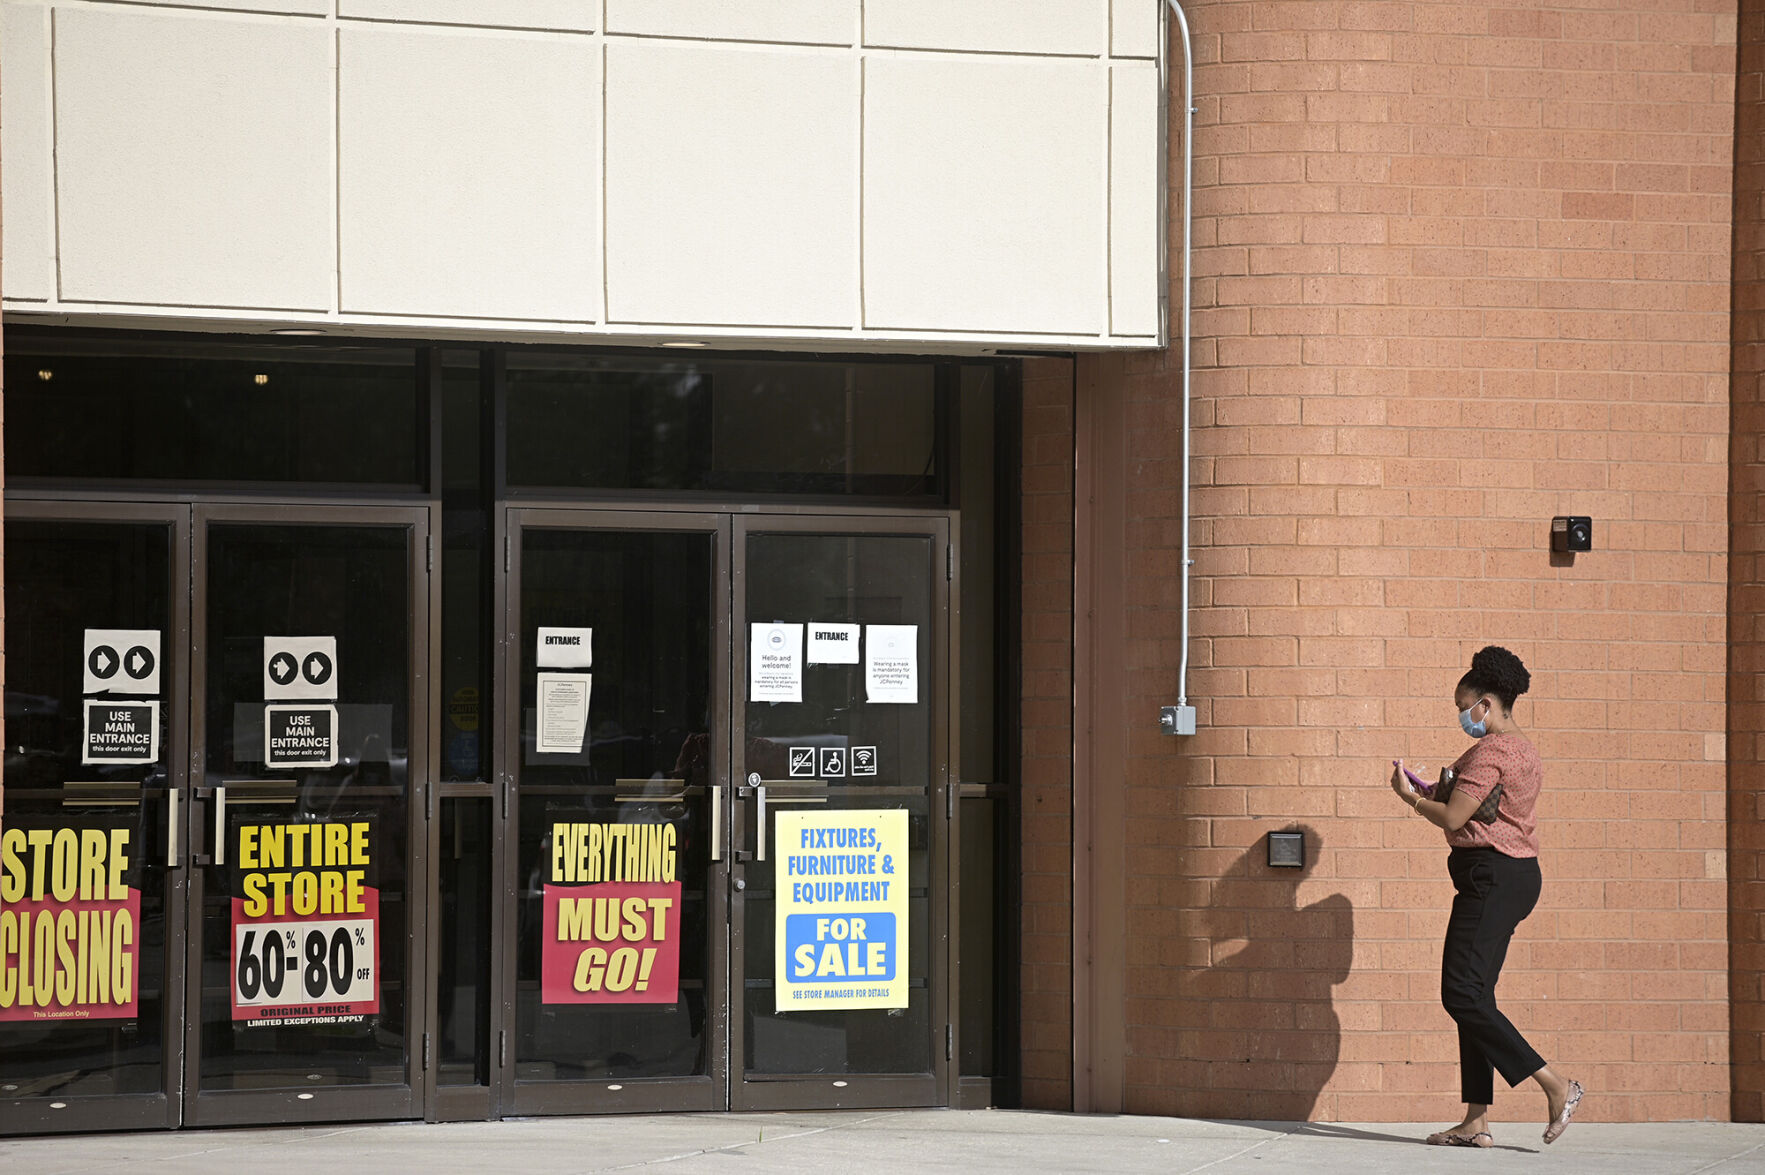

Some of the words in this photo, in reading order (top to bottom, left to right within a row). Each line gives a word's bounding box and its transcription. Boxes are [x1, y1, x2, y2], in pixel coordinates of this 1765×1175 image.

[545, 636, 580, 645] ENTRANCE
[815, 631, 848, 640] ENTRANCE
[110, 712, 131, 721] USE
[290, 716, 311, 725] USE
[105, 723, 135, 732] MAIN
[286, 727, 314, 736] MAIN
[90, 734, 150, 744] ENTRANCE
[272, 738, 329, 748] ENTRANCE
[240, 822, 369, 868] ENTIRE
[801, 828, 881, 852] FIXTURES,
[552, 823, 677, 883] EVERYTHING
[1, 828, 130, 903] STORE
[788, 855, 875, 876] FURNITURE
[882, 854, 894, 874] &
[243, 870, 366, 917] STORE
[793, 881, 890, 904] EQUIPMENT
[558, 897, 672, 941] MUST
[817, 918, 867, 941] FOR
[0, 908, 133, 1008] CLOSING
[794, 942, 886, 977] SALE
[357, 968, 369, 980] OFF
[573, 947, 657, 992] GO!
[793, 990, 802, 999] SEE
[804, 990, 822, 999] STORE
[824, 989, 854, 998] MANAGER
[856, 989, 866, 997] FOR
[868, 988, 889, 997] DETAILS
[261, 1006, 313, 1016] ORIGINAL
[318, 1005, 351, 1014] PRICE
[248, 1018, 282, 1027] LIMITED
[284, 1016, 336, 1025] EXCEPTIONS
